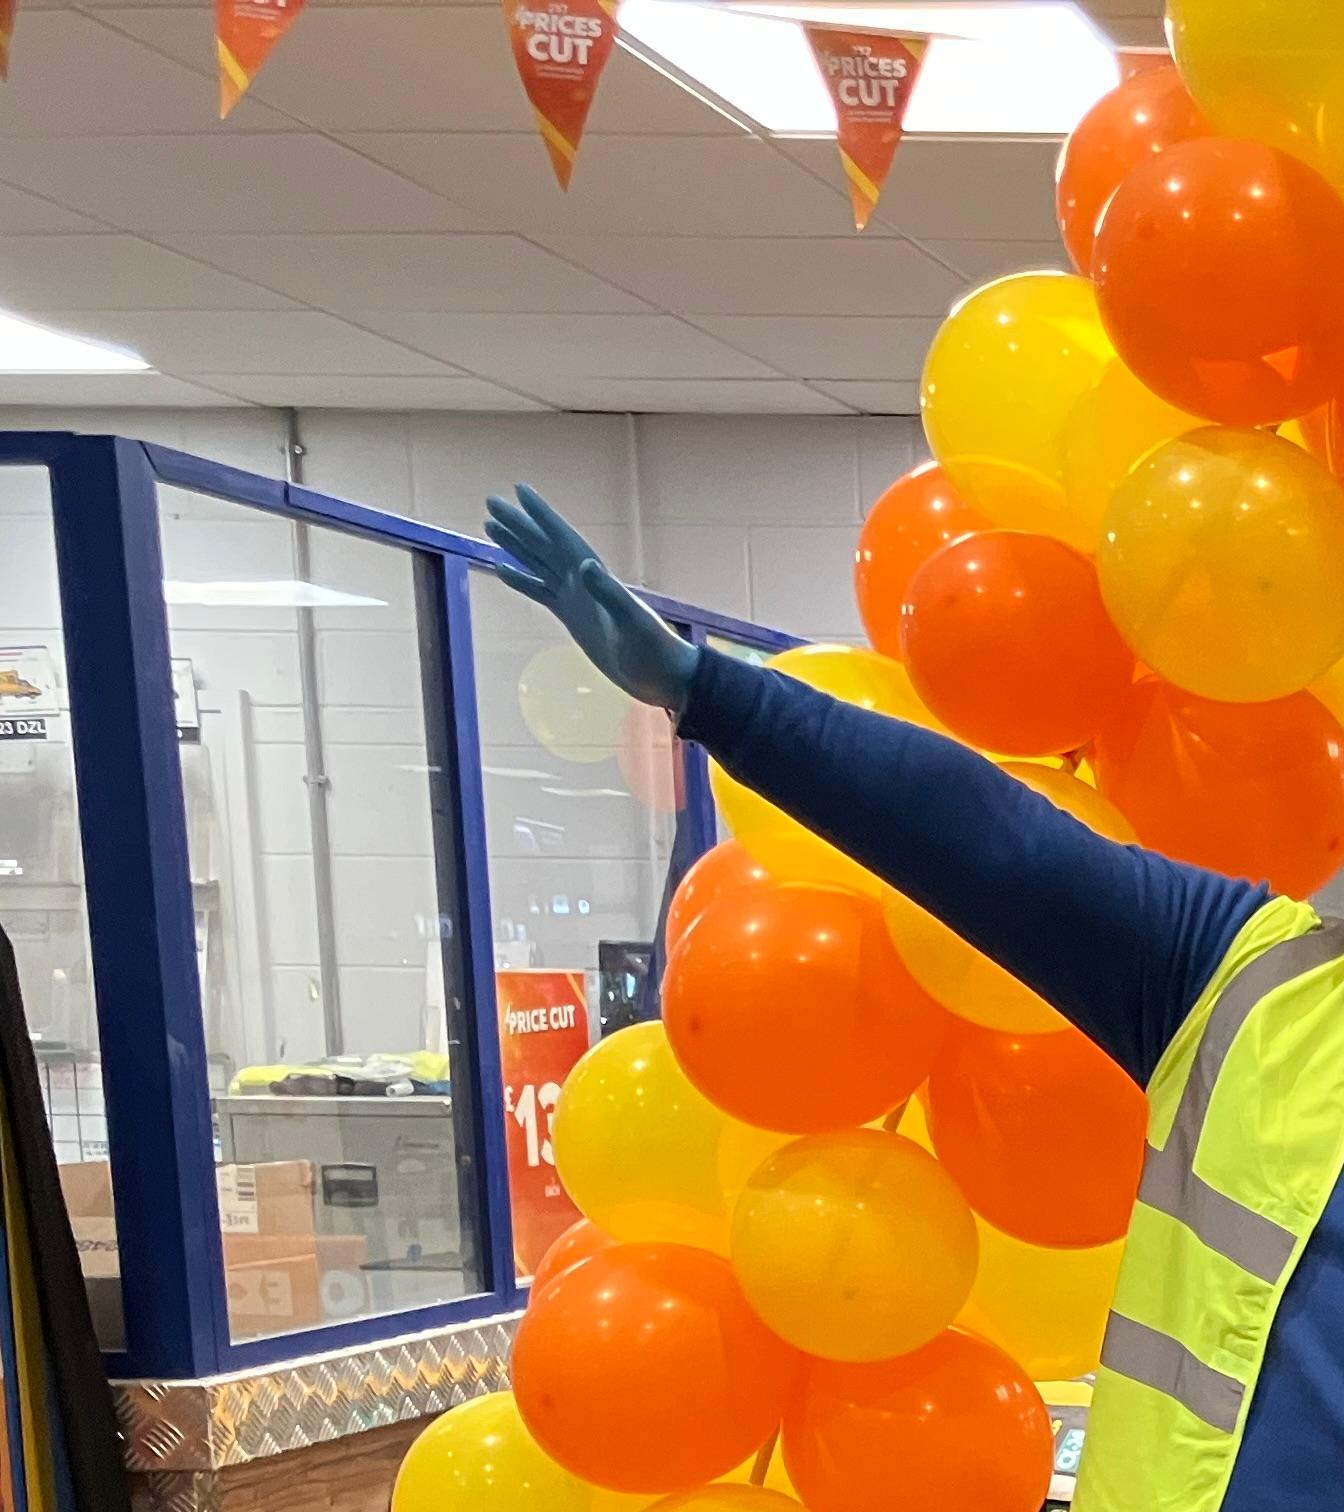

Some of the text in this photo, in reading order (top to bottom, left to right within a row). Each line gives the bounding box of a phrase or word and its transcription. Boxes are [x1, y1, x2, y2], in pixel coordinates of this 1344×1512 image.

[518, 11, 602, 38] PRICES
[527, 33, 593, 65] CUT
[825, 56, 907, 78] PRICES
[839, 78, 899, 107] CUT
[17, 721, 46, 734] DZL
[509, 1005, 576, 1034] PRICE CUT
